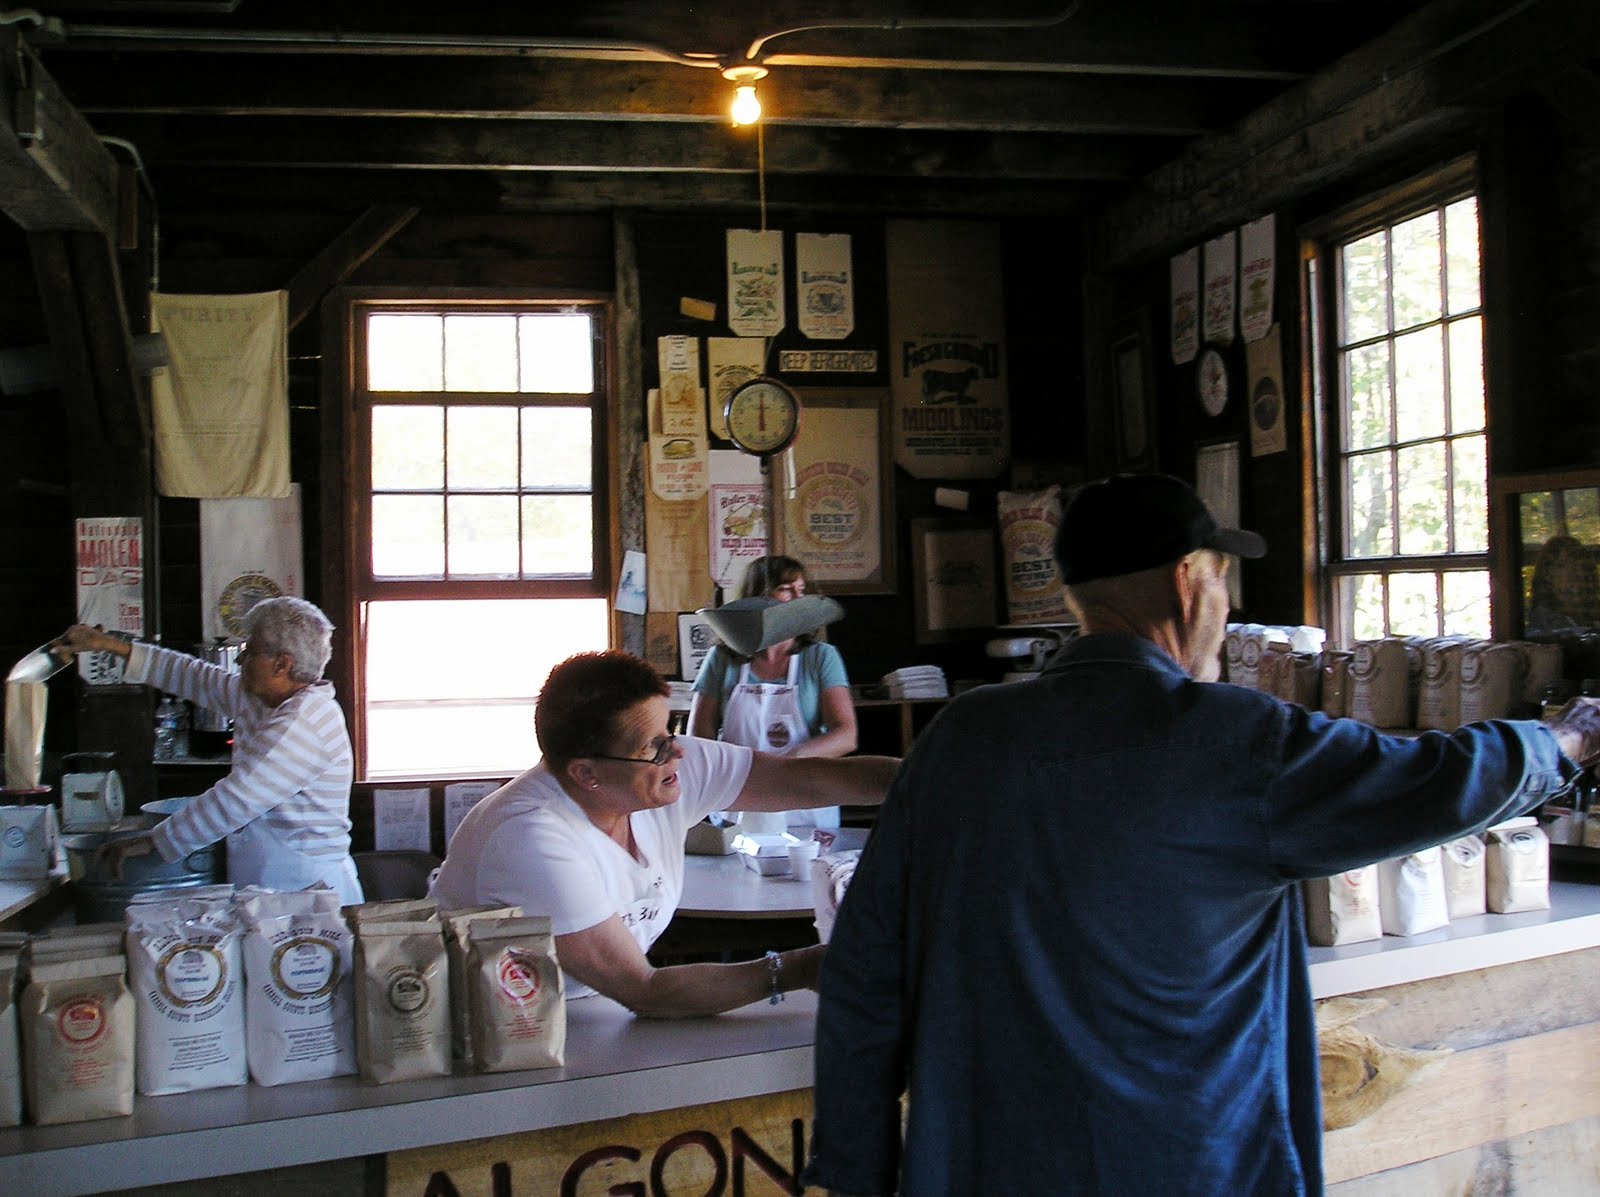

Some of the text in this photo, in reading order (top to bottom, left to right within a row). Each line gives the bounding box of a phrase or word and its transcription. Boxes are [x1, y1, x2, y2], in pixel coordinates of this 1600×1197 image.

[809, 513, 854, 524] BEST
[80, 539, 140, 568] MOLEN
[1011, 560, 1053, 573] BEST
[80, 569, 141, 586] DAG
